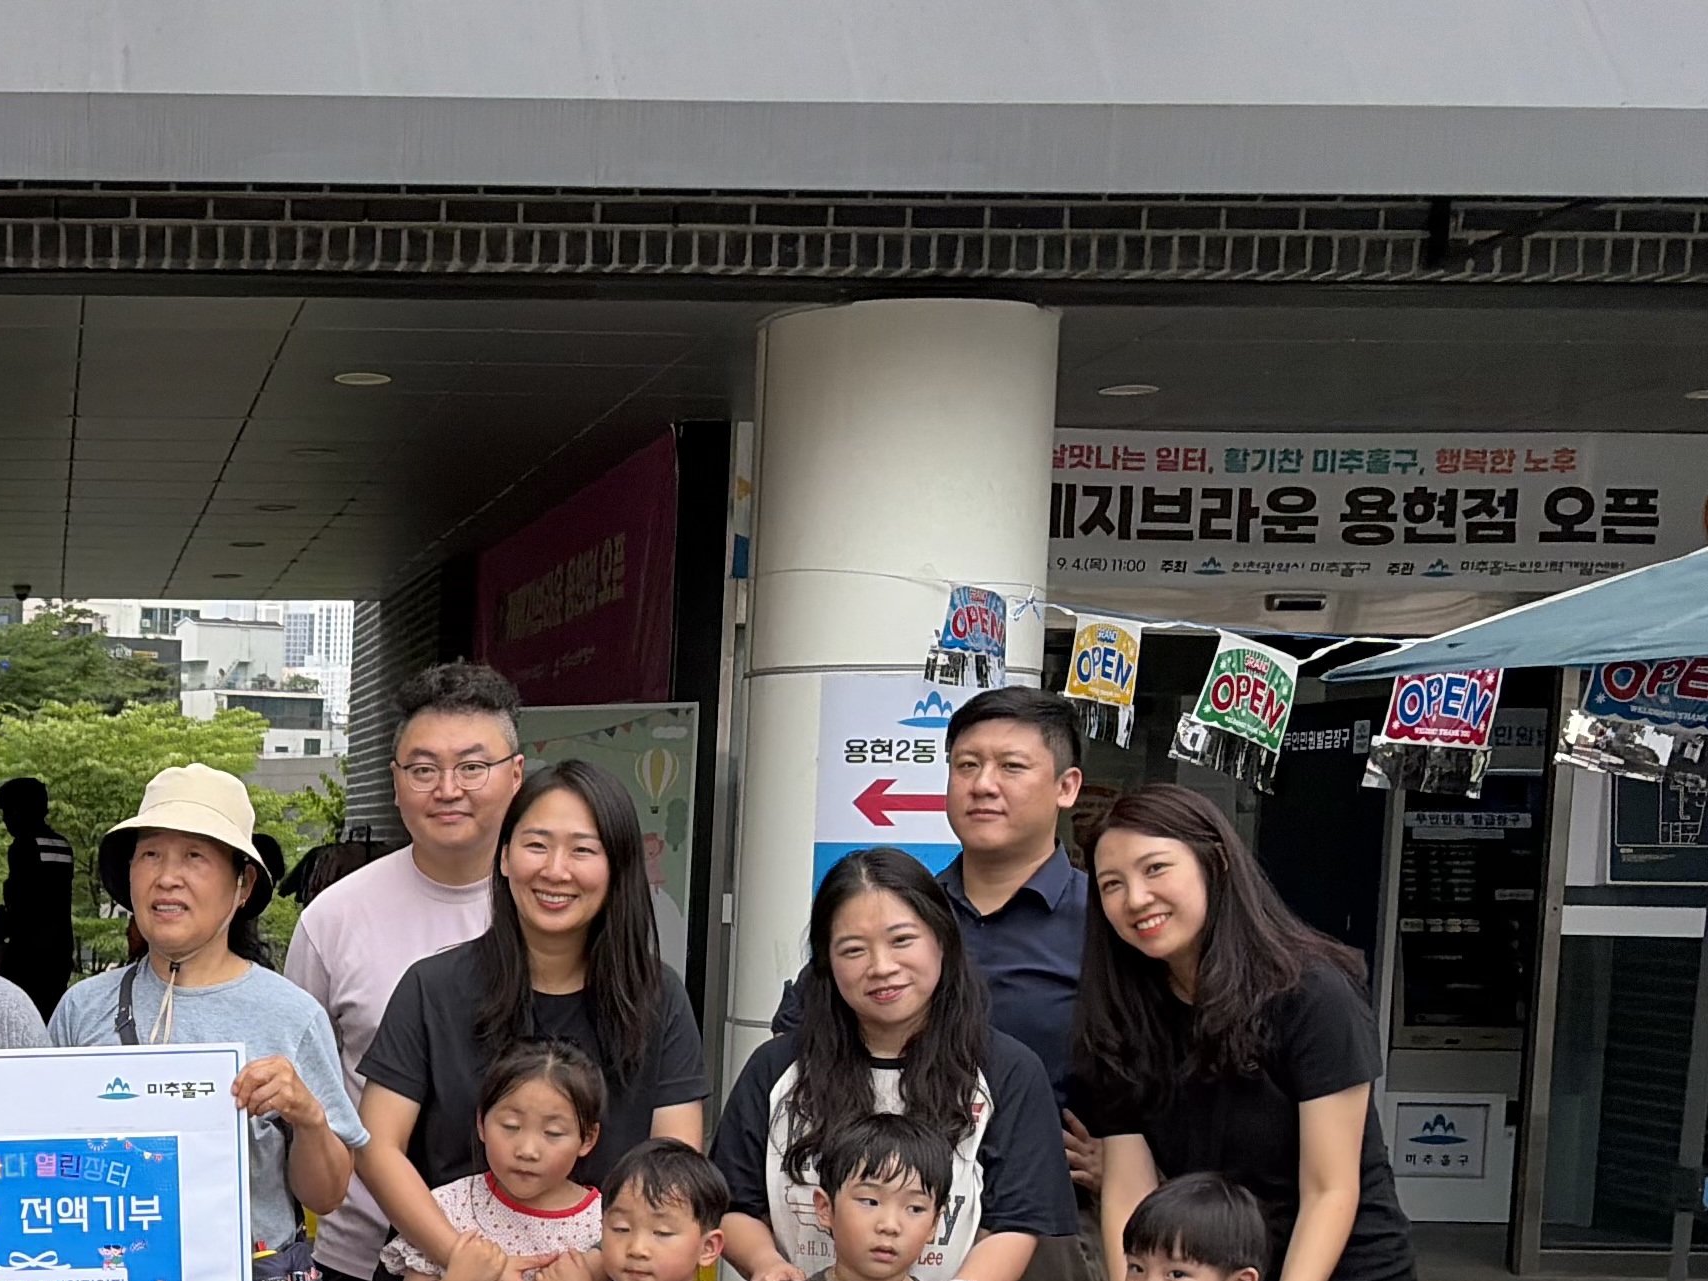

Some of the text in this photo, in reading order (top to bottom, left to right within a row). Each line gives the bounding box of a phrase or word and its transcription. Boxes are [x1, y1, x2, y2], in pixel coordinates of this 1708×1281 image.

[1156, 447, 1214, 474] 일터,
[1224, 447, 1303, 474] 활기찬
[1312, 447, 1425, 476] 미추홀구,
[1435, 448, 1516, 474] 행복한
[1523, 447, 1577, 473] 노후
[1340, 486, 1519, 546] 용현점
[1538, 486, 1660, 545] 오픈
[1111, 559, 1146, 572] 11:00
[1159, 560, 1188, 574] 주최
[1387, 562, 1414, 576] 주관
[951, 605, 1005, 647] OPEN
[1077, 646, 1133, 690] OPEN
[1210, 672, 1287, 732] OPEN
[1397, 673, 1493, 729] OPEN
[844, 738, 937, 764] 용현2동
[147, 1080, 216, 1099] 미추홀구
[1405, 1153, 1470, 1167] 미추홀구
[20, 1194, 163, 1235] 전액기부
